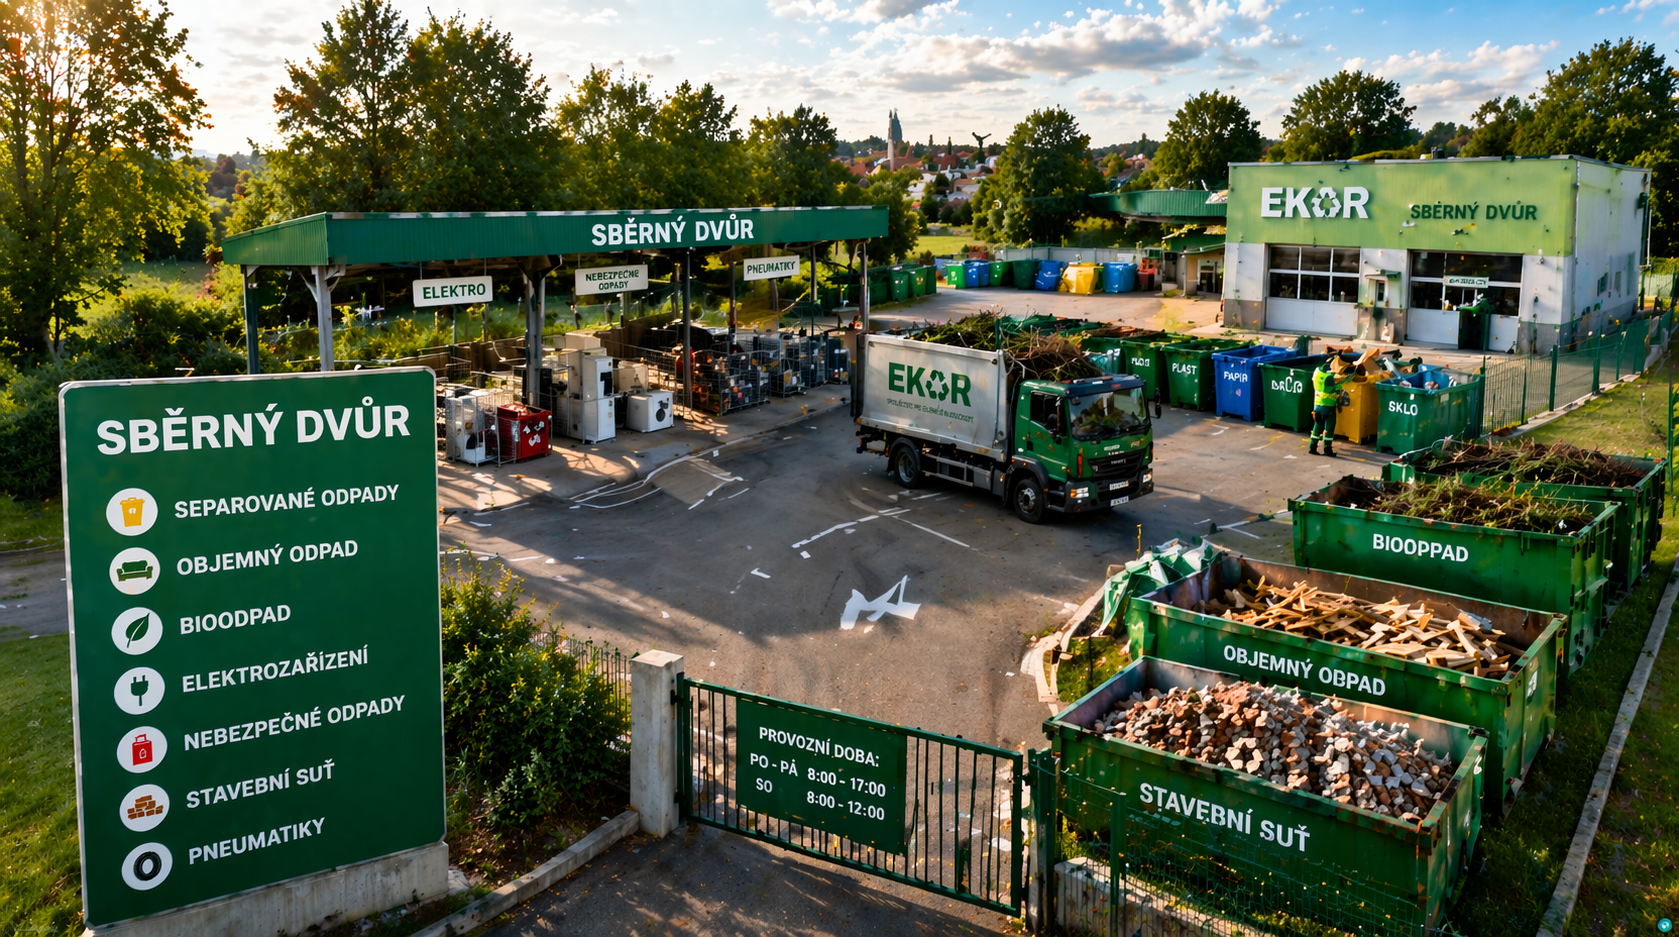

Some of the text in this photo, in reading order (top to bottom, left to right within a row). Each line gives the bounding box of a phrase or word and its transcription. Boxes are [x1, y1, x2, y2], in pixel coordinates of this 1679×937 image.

[592, 213, 754, 246] SBĚRNÝ DVŮR
[422, 283, 486, 300] ELEKTRO
[1172, 363, 1197, 375] PLAST
[97, 396, 411, 456] SBĚRNÝ DVŮR
[1388, 400, 1418, 416] SKLO
[174, 484, 399, 519] SEPAROVANÉ ODPADY
[177, 540, 358, 576] OBJEMNÝ ODPAD
[1373, 533, 1469, 562] BIOOPPAD
[180, 605, 291, 635] BIOODPAD
[182, 644, 369, 693] ELEKTROZAŘÍZENÍ
[1223, 644, 1386, 696] OBJEMNÝ OBPAD
[184, 695, 405, 751] NEBEZPEČNÉ ODPADY
[759, 726, 880, 768] PROVOZNÍ DOBA:
[186, 759, 335, 809] STAVEBNÍ SUŤ
[750, 752, 769, 769] PO
[807, 767, 837, 786] 8:00
[850, 777, 886, 797] 17:00
[756, 778, 773, 793] SO
[806, 790, 835, 809] 8:00
[847, 800, 885, 820] 12:00
[1139, 782, 1311, 852] STAVEBNÍ SUŤ
[189, 817, 325, 865] PNEUMATIKY
